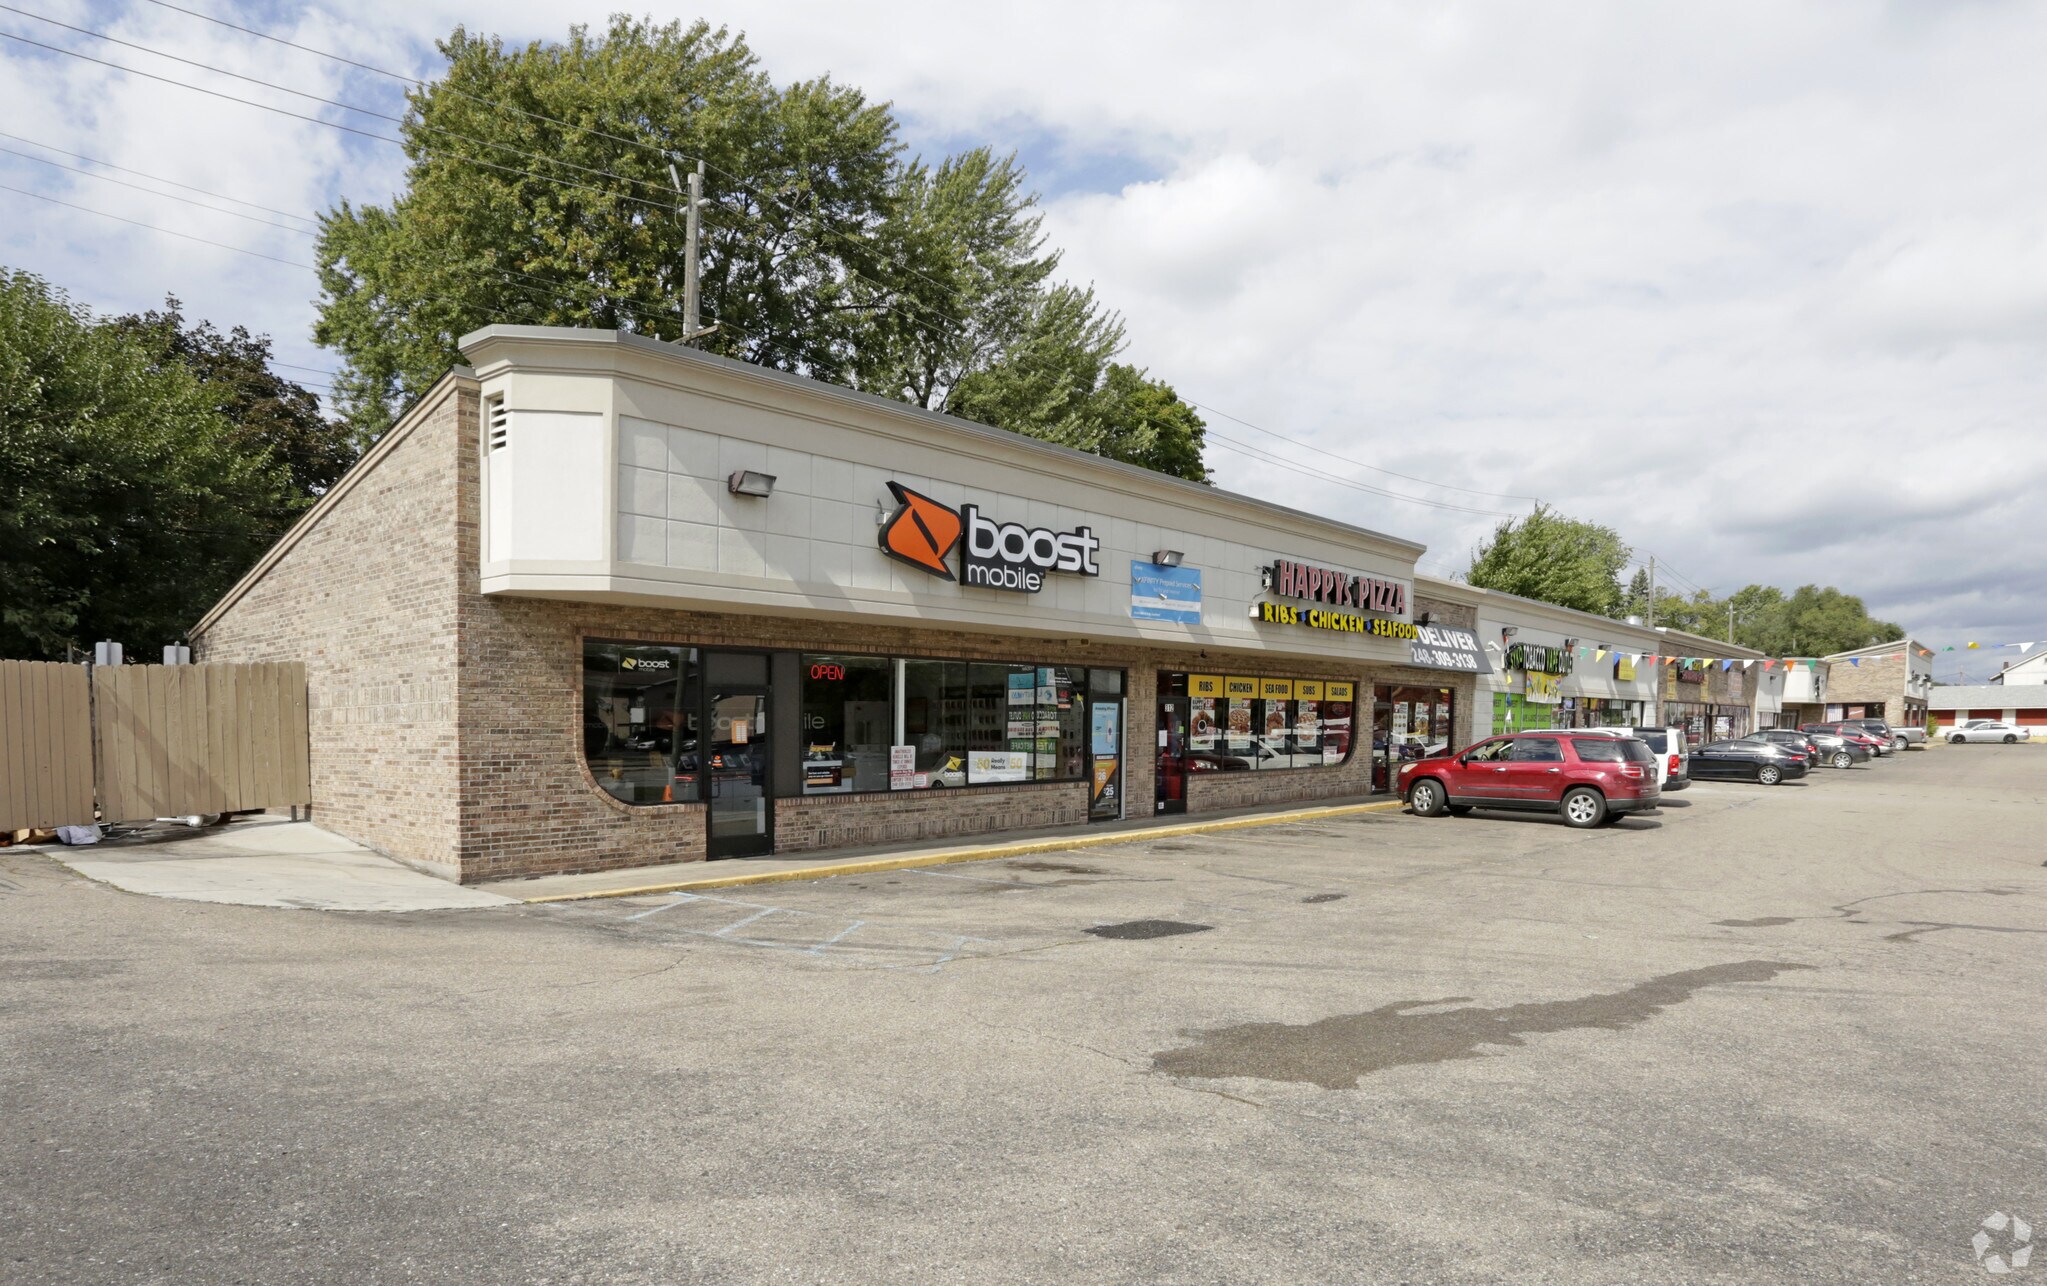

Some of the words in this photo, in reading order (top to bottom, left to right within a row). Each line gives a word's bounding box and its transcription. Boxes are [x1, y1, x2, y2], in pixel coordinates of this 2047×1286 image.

[968, 507, 1099, 575] boost
[967, 564, 1042, 591] mobile
[1358, 576, 1406, 615] PIZZA
[1264, 602, 1298, 624] RIBS
[1309, 609, 1364, 633] CHICKEN
[1373, 618, 1418, 640] SEAFOOD
[1416, 625, 1478, 652] DELIVER
[637, 659, 670, 669] boost
[1411, 647, 1478, 669] 248-309-3138
[810, 664, 845, 681] OPEN
[1198, 680, 1213, 692] RIBS
[1229, 682, 1253, 693] CHICKEN
[1265, 683, 1275, 694] SEA
[1275, 684, 1289, 695] FOOD
[1302, 685, 1316, 695] SUBS
[1331, 687, 1348, 697] SALADS
[1010, 758, 1022, 769] 50
